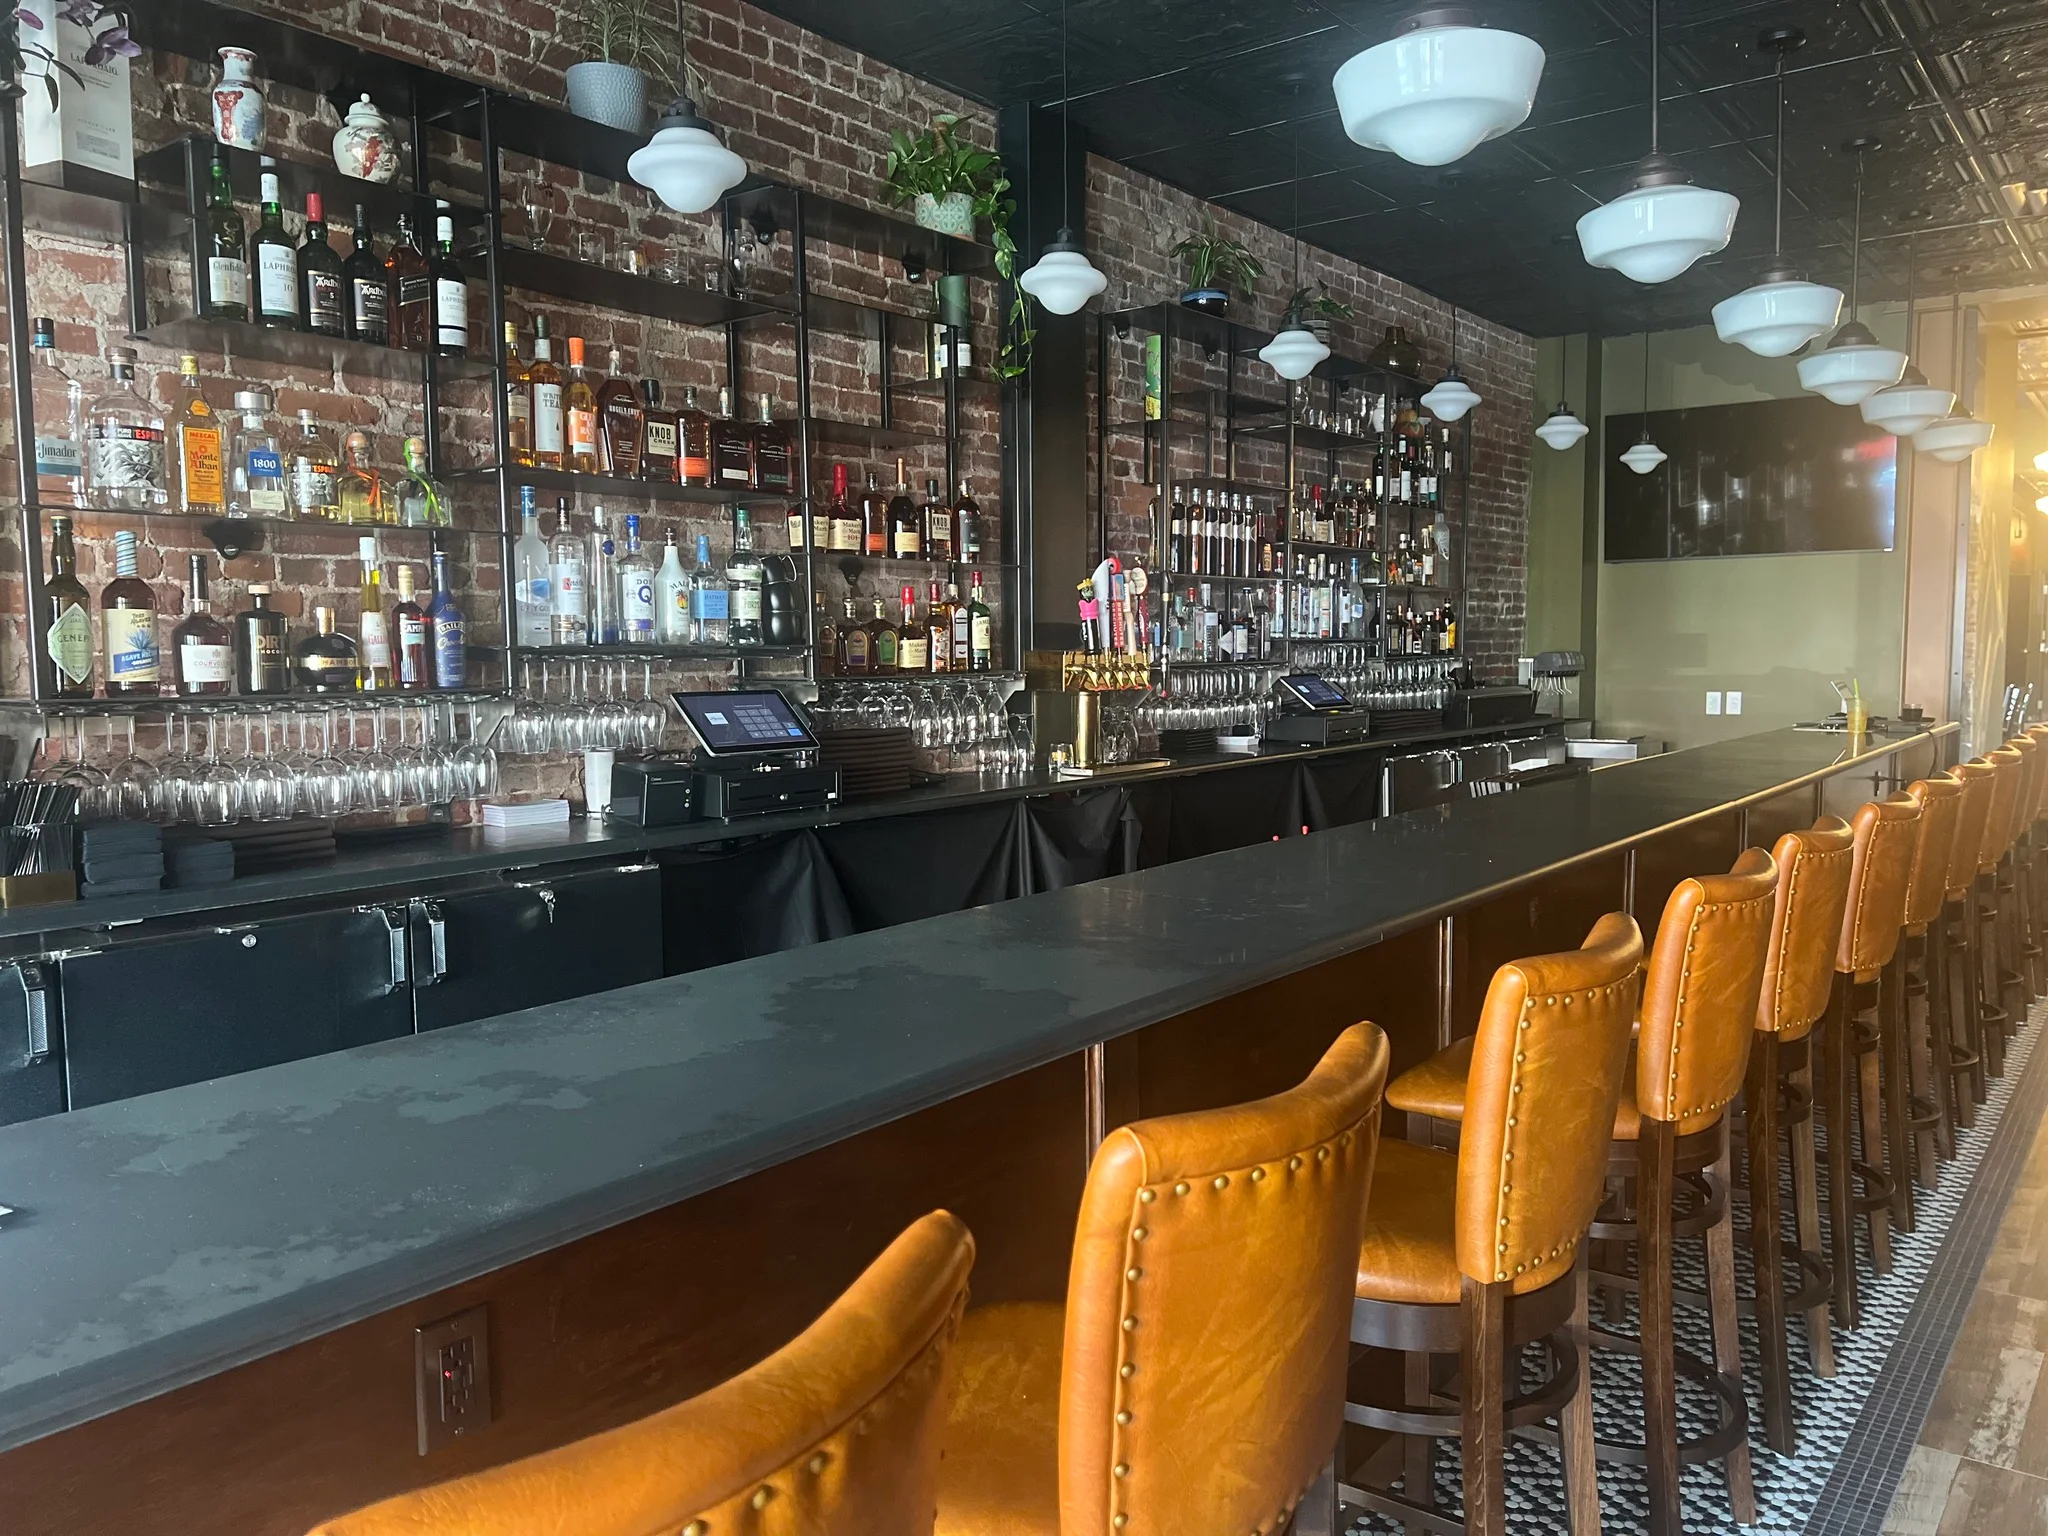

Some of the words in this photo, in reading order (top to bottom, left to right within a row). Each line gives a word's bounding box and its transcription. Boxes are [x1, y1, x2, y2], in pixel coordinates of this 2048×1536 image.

[70, 52, 119, 76] LAPROAIG
[283, 283, 293, 293] 10
[189, 431, 215, 439] MEZCAL
[649, 425, 671, 440] KNOB
[38, 443, 77, 458] Jimador
[189, 451, 218, 461] Monte
[190, 459, 218, 471] Alban
[253, 458, 276, 469] 1800
[638, 585, 652, 606] Q
[256, 634, 287, 649] DIRT
[121, 653, 141, 662] AGAVE
[319, 658, 356, 666] HAMBO
